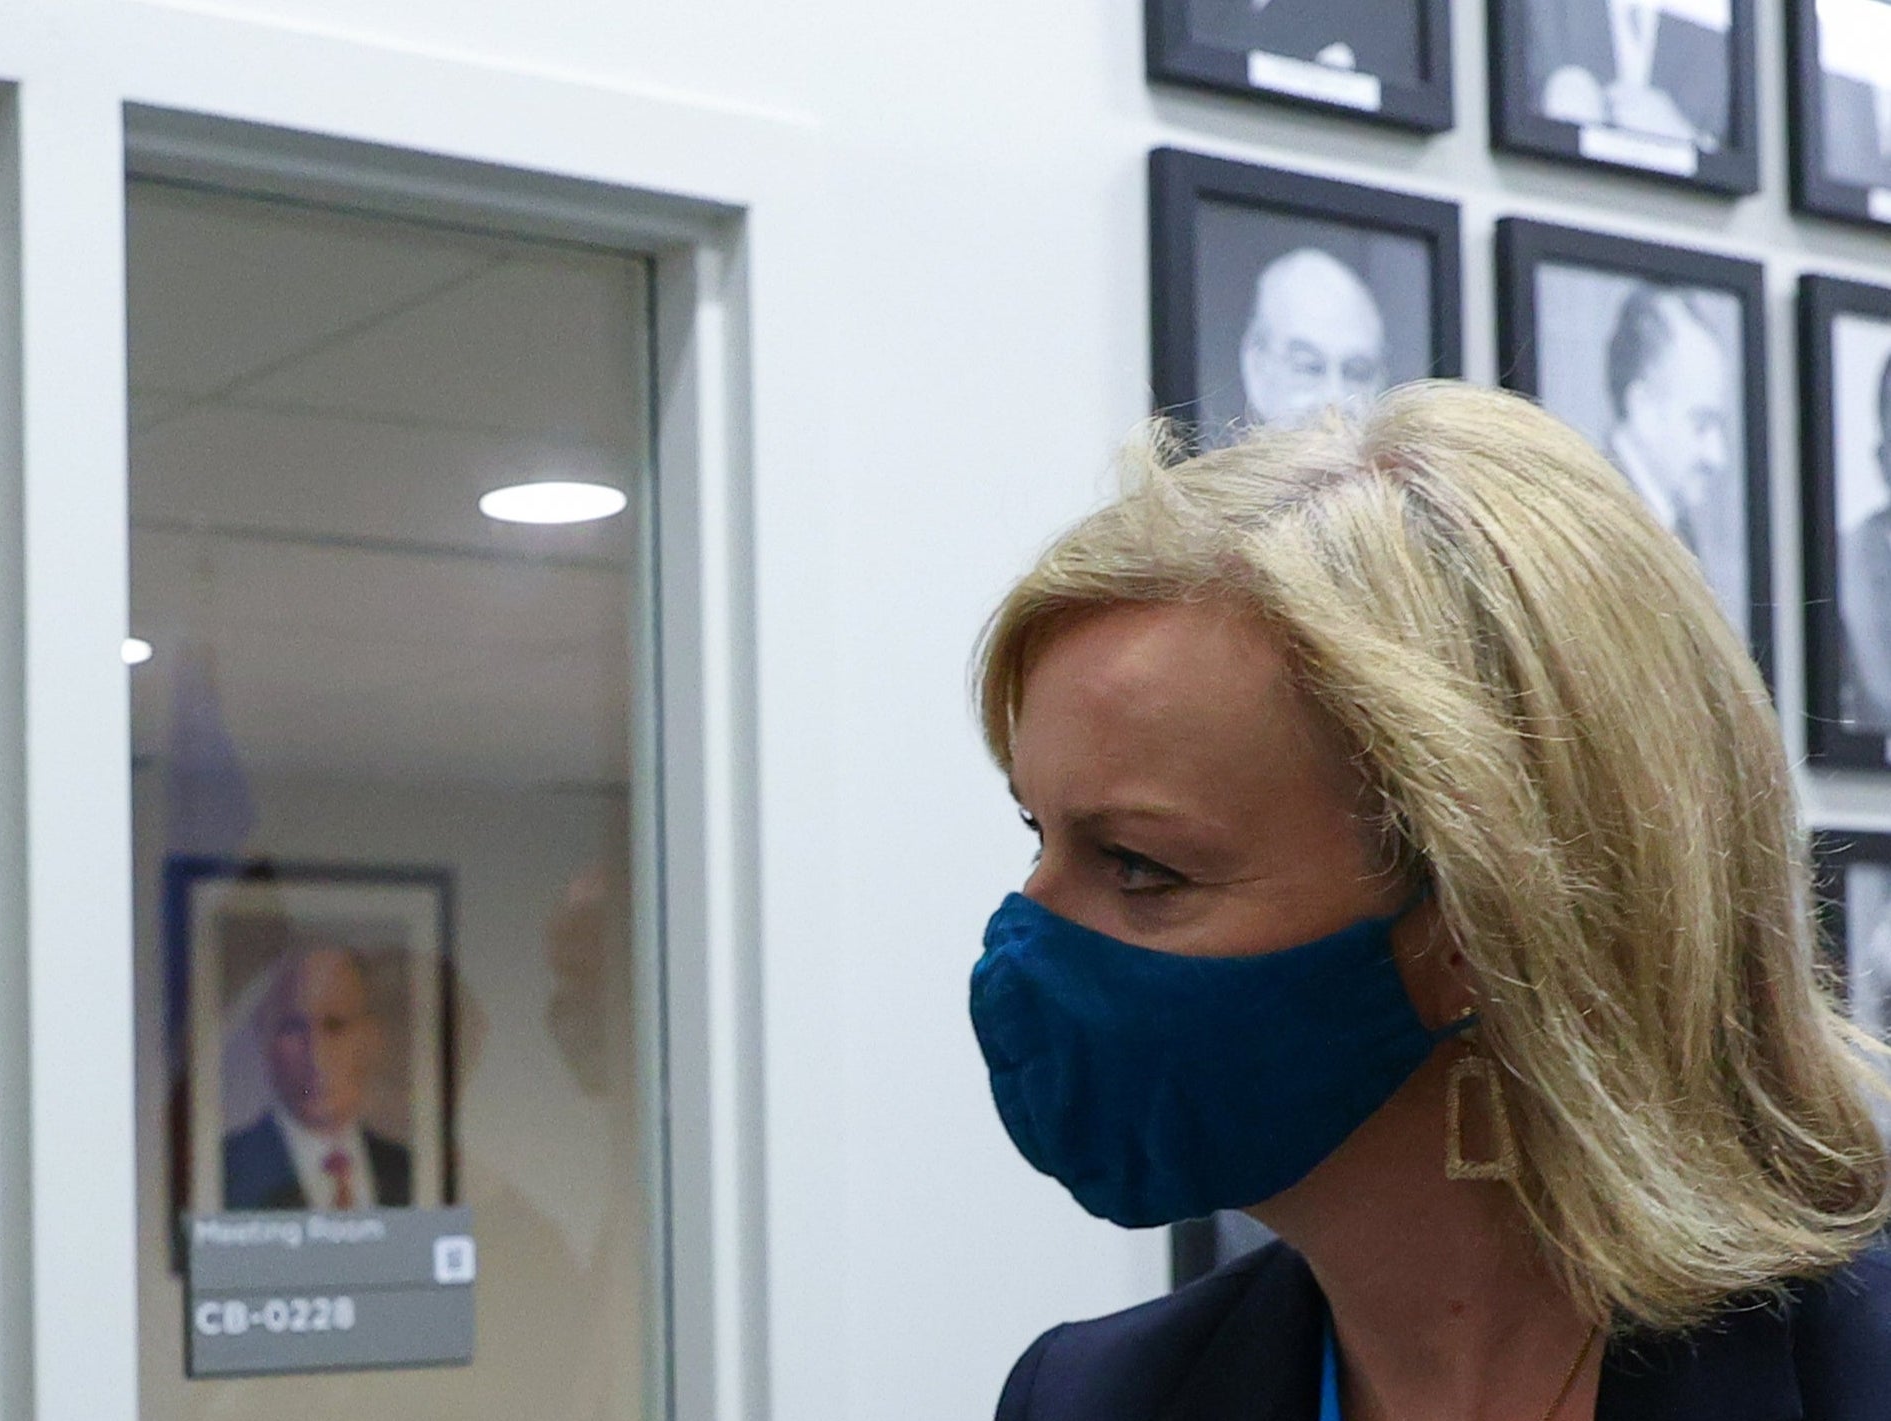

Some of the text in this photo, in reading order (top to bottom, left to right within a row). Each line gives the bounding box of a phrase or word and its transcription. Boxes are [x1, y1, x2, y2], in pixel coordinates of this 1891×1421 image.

[194, 1216, 386, 1248] Meeting Room
[195, 1297, 356, 1335] CB-0228
